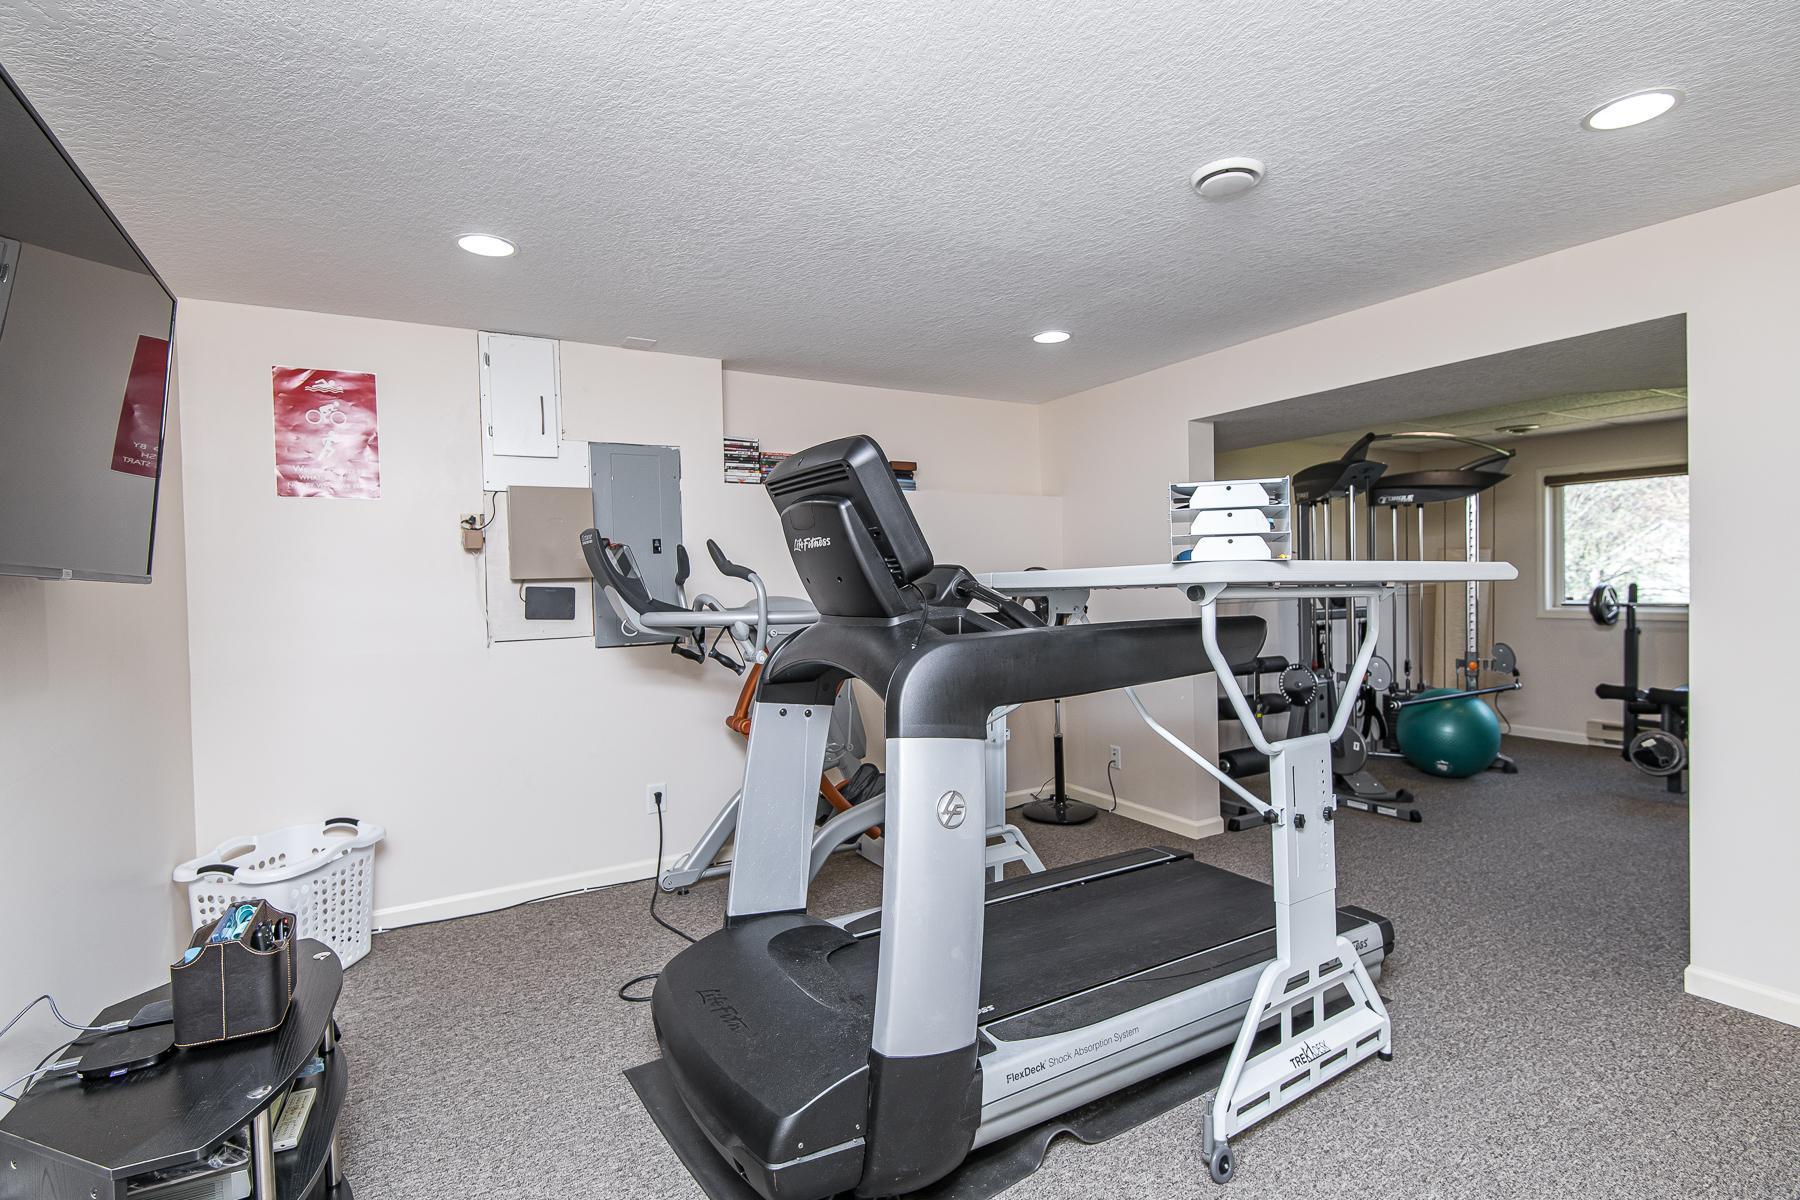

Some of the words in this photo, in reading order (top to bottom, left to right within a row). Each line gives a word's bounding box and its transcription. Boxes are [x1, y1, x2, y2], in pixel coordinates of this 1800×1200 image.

[1048, 1051, 1073, 1068] Shock
[1073, 1036, 1113, 1058] Absorption
[1113, 1026, 1140, 1043] System
